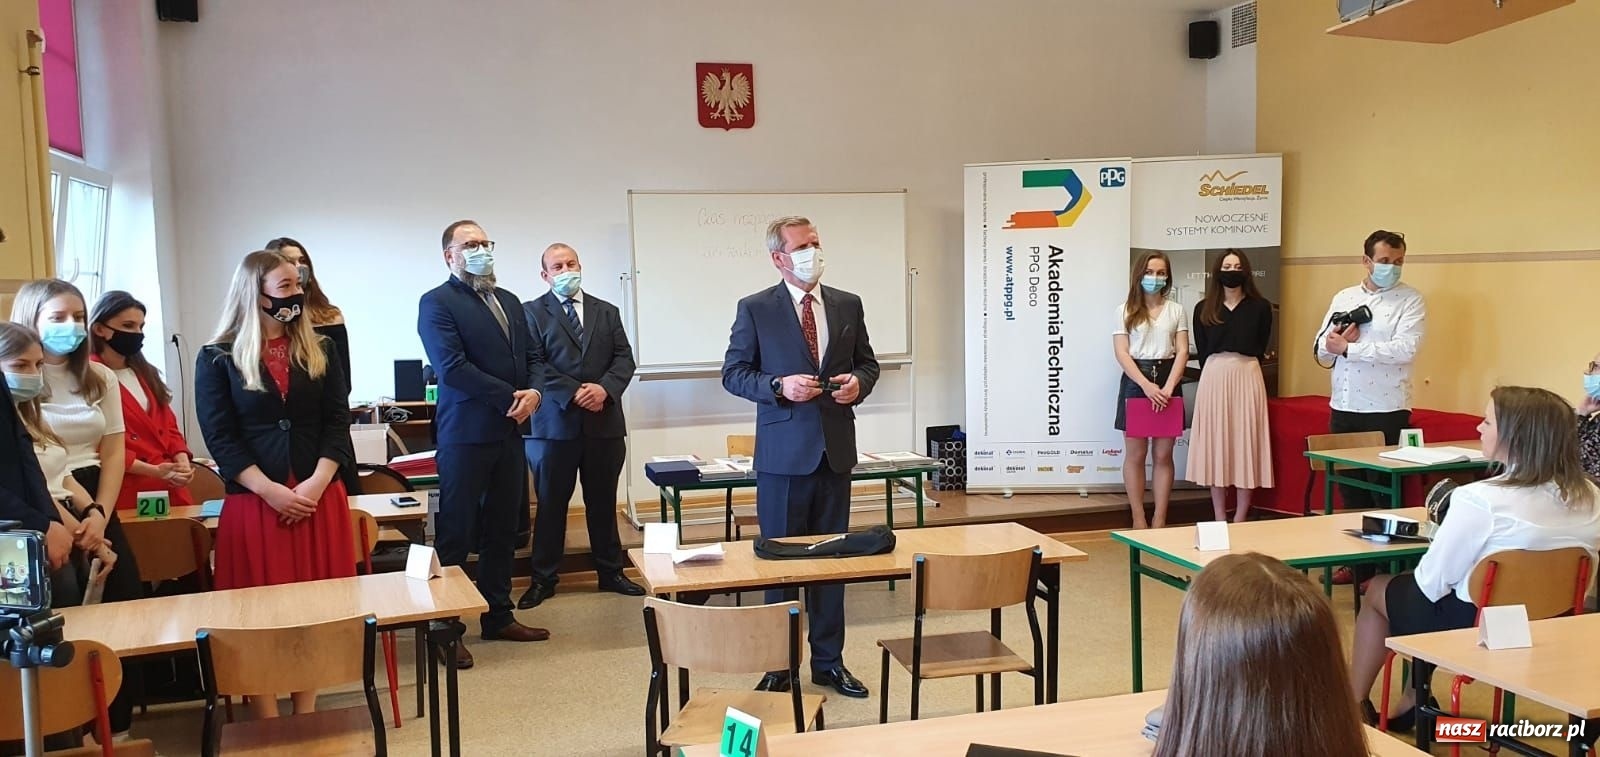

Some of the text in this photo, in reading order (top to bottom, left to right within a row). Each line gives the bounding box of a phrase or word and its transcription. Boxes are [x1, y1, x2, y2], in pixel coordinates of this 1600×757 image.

[1100, 168, 1125, 186] PPG
[1194, 213, 1269, 224] NOWOCZESNE
[1166, 224, 1269, 236] SYSTEMY KOMINOWE
[1004, 246, 1015, 321] www.atppg.pl
[1029, 246, 1040, 307] PPG Deco
[140, 498, 166, 515] 20
[727, 722, 753, 757] 14
